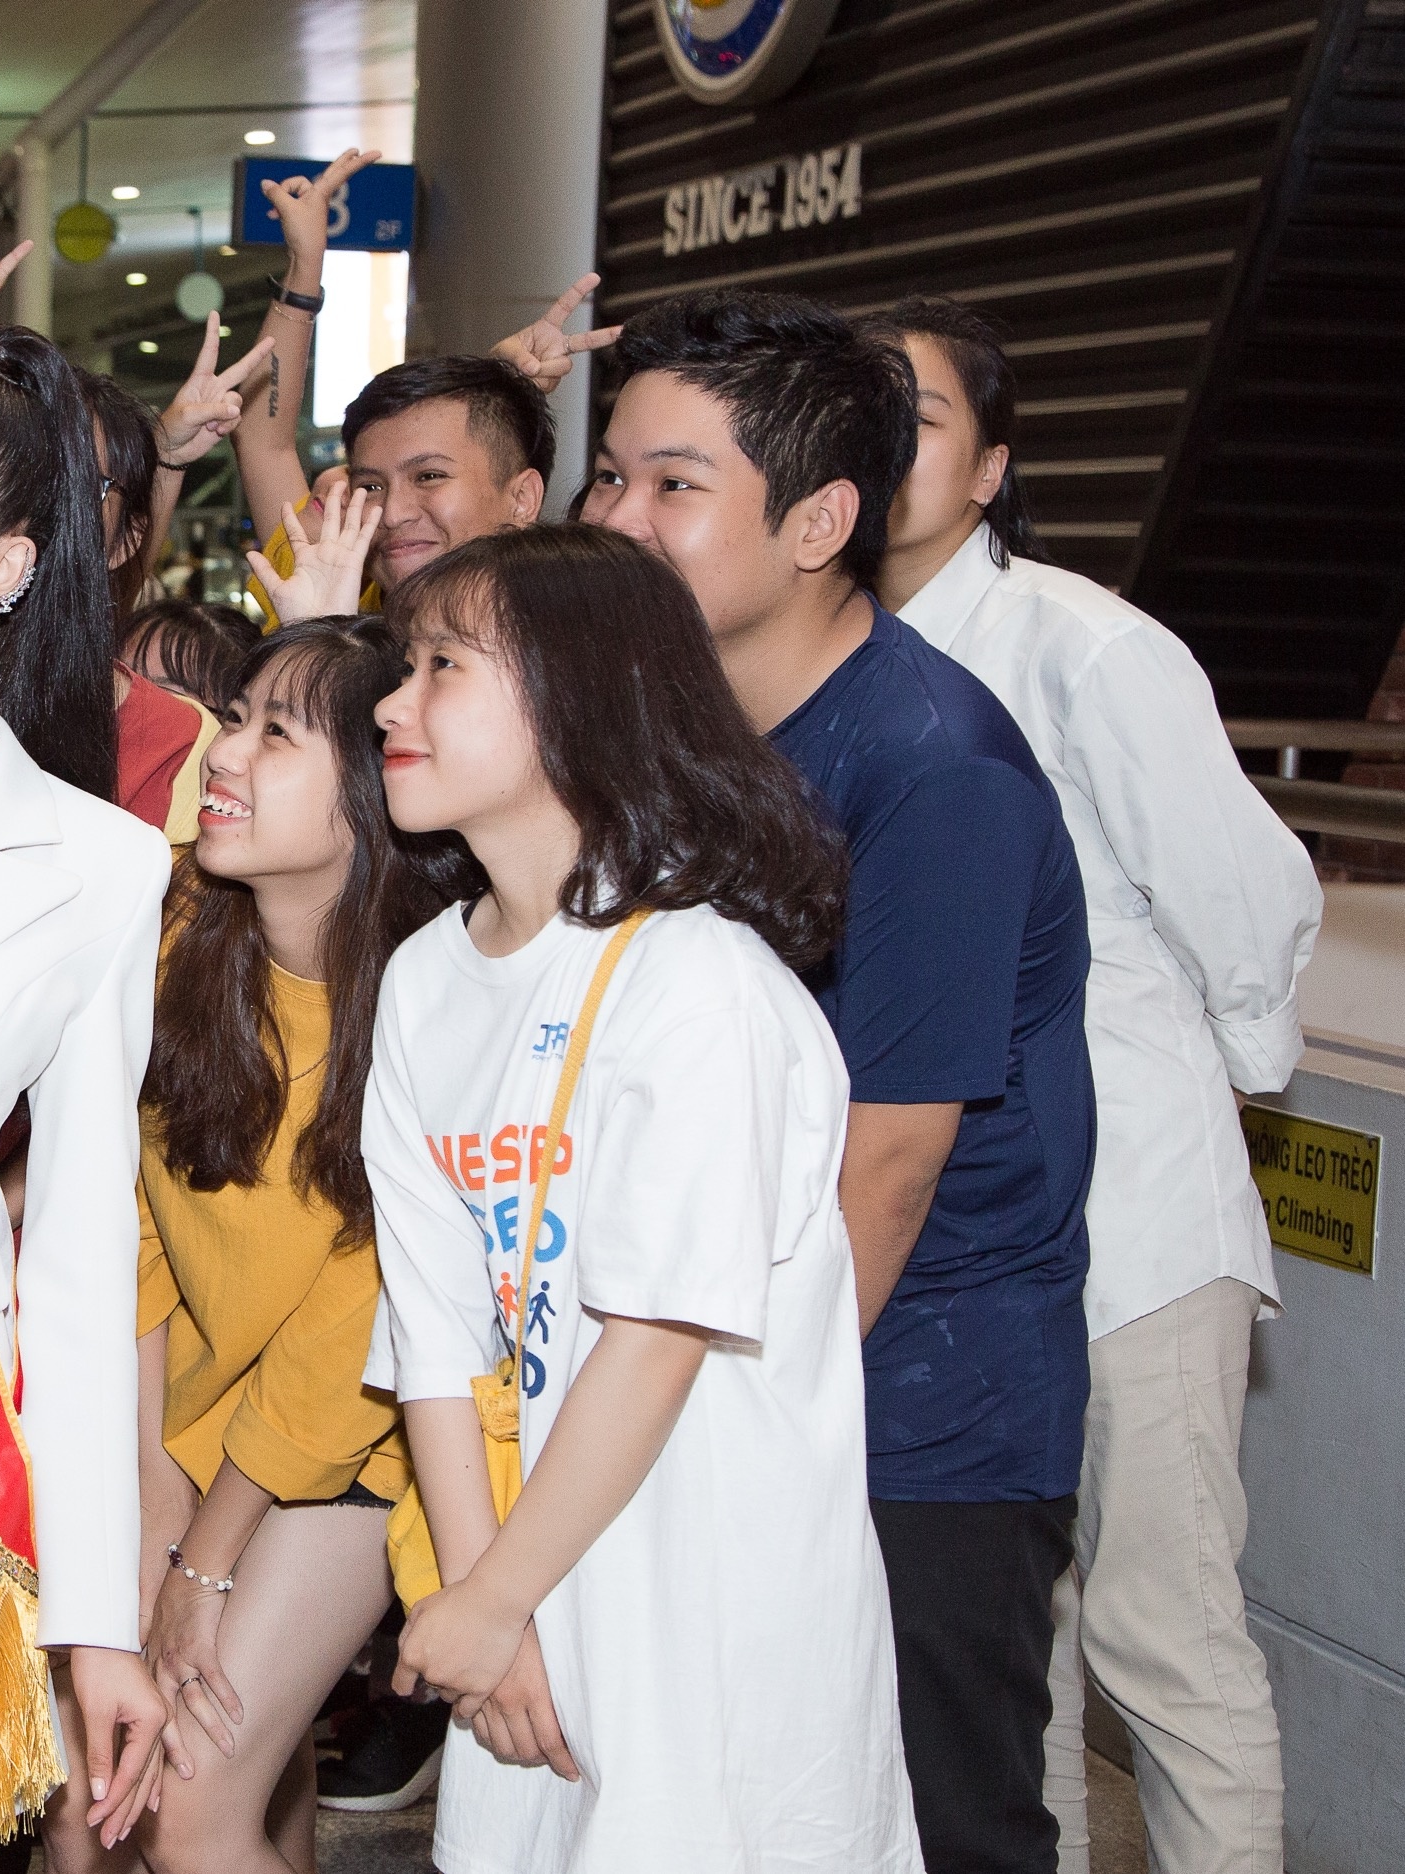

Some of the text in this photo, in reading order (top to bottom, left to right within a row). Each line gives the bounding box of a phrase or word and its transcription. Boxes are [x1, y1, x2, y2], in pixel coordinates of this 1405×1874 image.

[663, 143, 862, 258] SINCE 1954
[1244, 1123, 1374, 1195] HÔNG LEO TRÈO
[1276, 1195, 1354, 1255] Climbing
